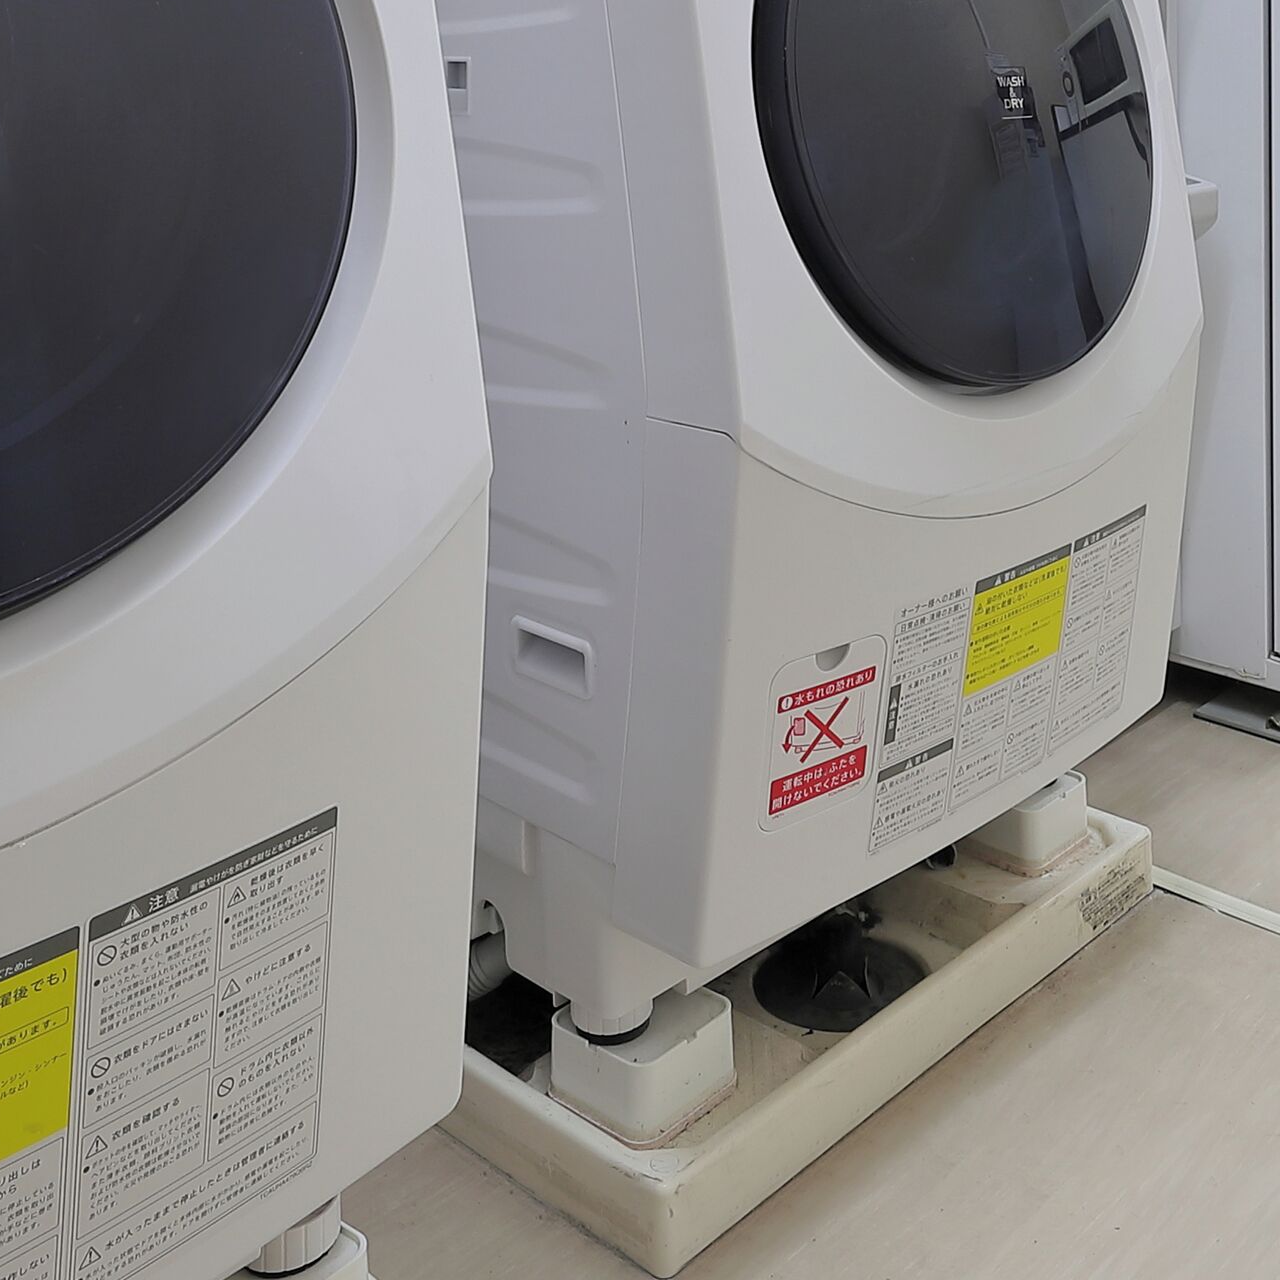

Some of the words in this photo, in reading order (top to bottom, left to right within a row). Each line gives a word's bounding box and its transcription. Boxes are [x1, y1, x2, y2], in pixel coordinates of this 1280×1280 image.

[997, 76, 1025, 88] WASH
[1004, 98, 1025, 109] DRY
[149, 886, 180, 913] 注意
